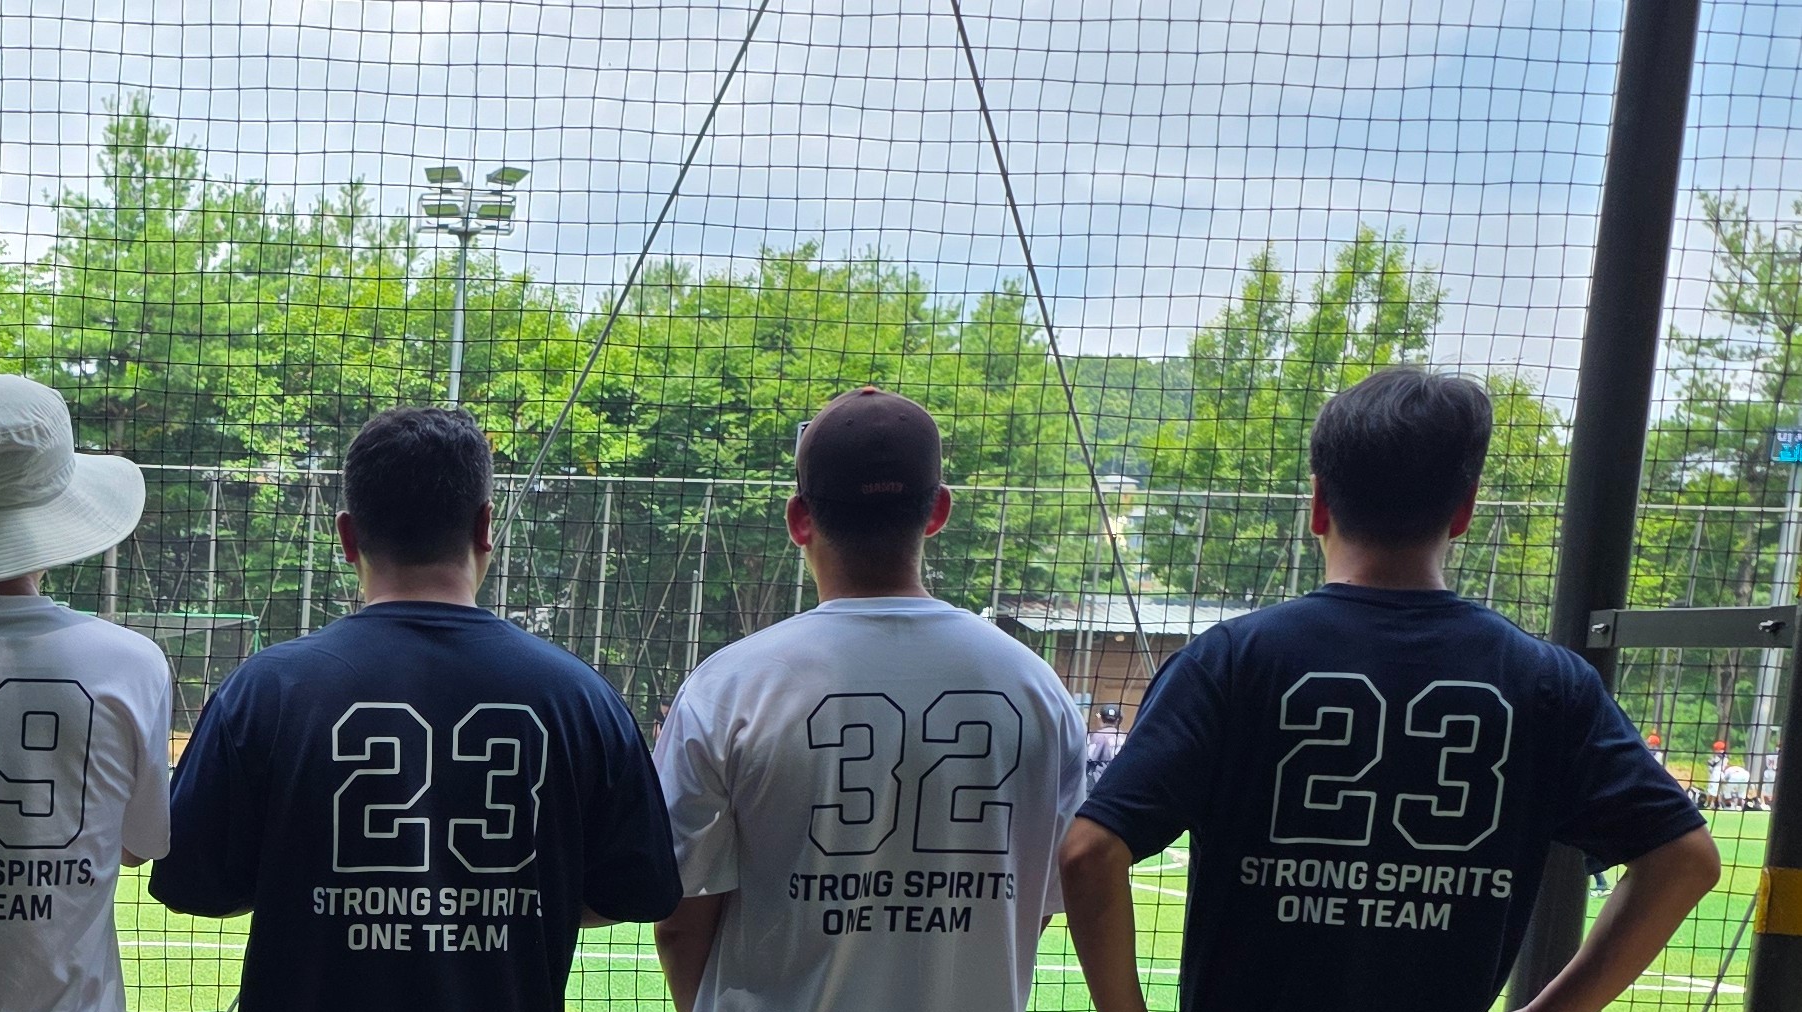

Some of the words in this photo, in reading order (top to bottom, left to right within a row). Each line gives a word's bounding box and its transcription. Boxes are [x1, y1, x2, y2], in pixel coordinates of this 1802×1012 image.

[807, 689, 1023, 856] 32
[1269, 671, 1515, 852] 23
[331, 702, 549, 874] 23
[789, 871, 893, 901] STRONG
[1240, 856, 1368, 890] STRONG
[313, 887, 431, 916] STRONG
[1277, 895, 1348, 926] ONE
[1357, 898, 1452, 931] TEAM
[348, 923, 413, 951] ONE
[422, 924, 508, 952] TEAM
[822, 906, 874, 936] ONE
[883, 906, 972, 933] TEAM
